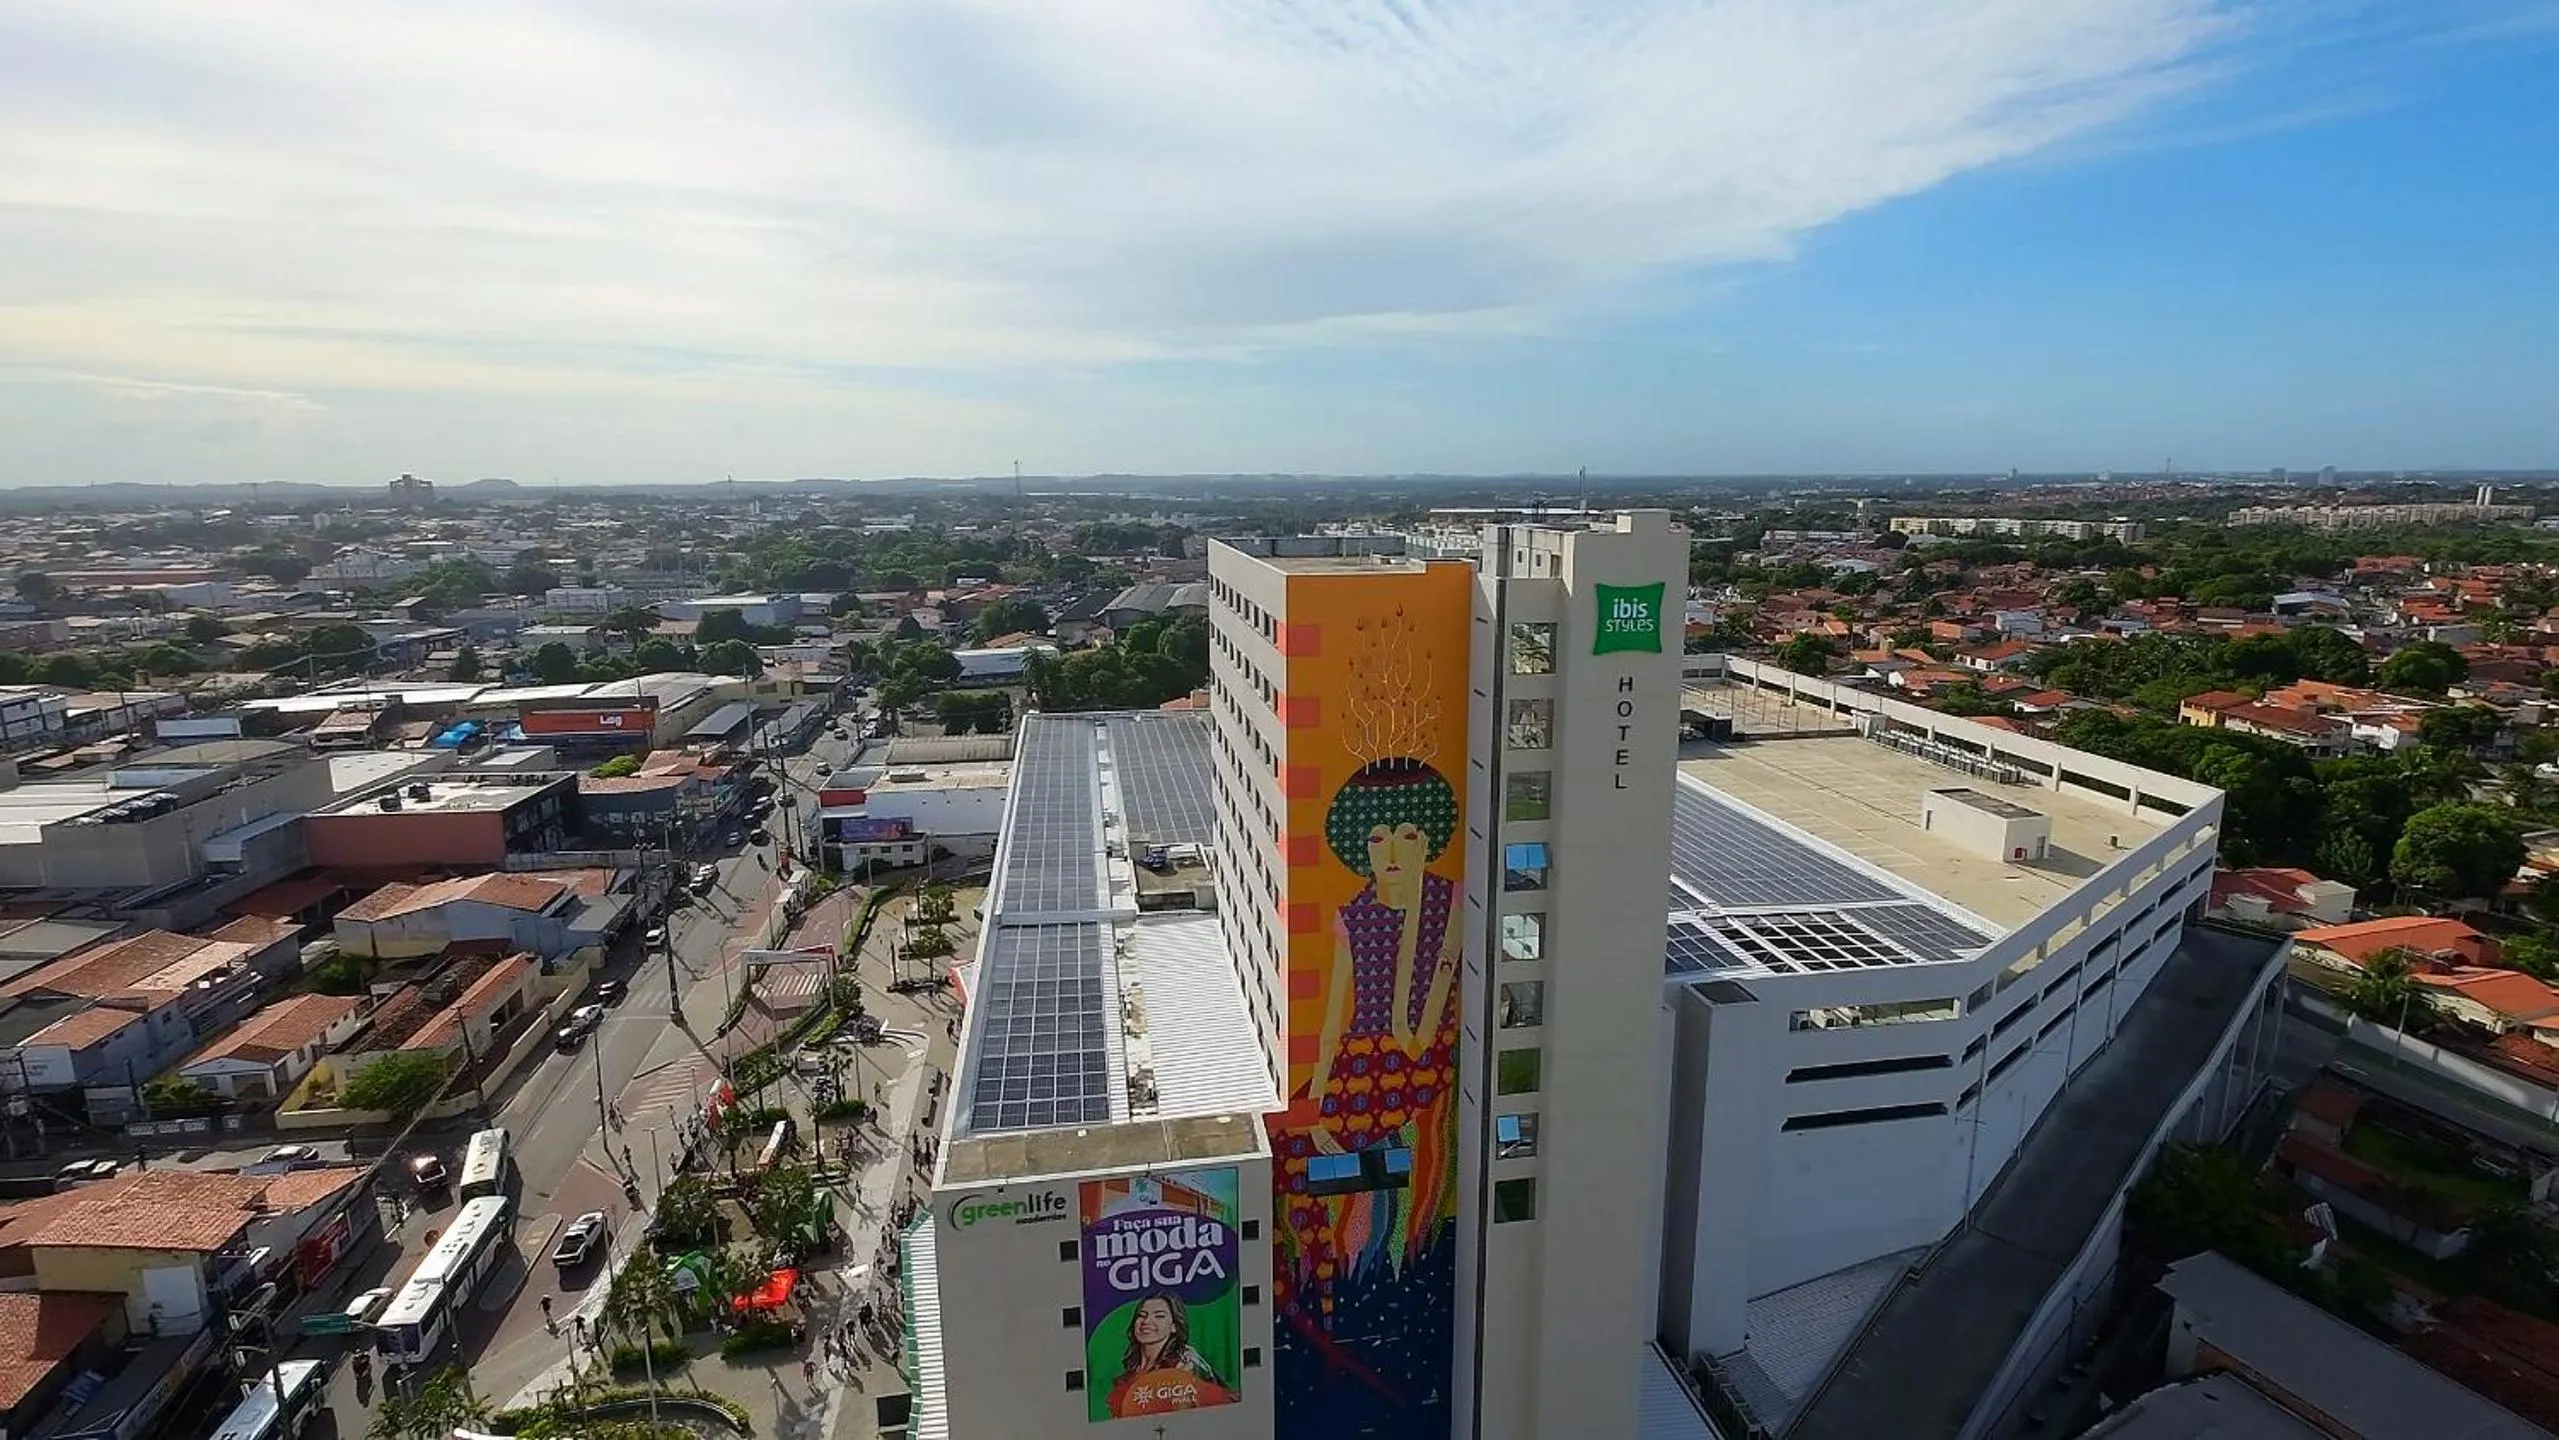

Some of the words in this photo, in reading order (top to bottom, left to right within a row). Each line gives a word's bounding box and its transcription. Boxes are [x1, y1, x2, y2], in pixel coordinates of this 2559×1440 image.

[1613, 598, 1648, 618] ibis
[1615, 676, 1633, 789] HOTEL
[962, 1191, 1067, 1226] greenlife
[1113, 1218, 1151, 1232] Faça
[1154, 1216, 1181, 1227] sua
[1095, 1217, 1224, 1258] moda
[1109, 1249, 1225, 1290] GIGA
[1157, 1383, 1197, 1399] GIGA
